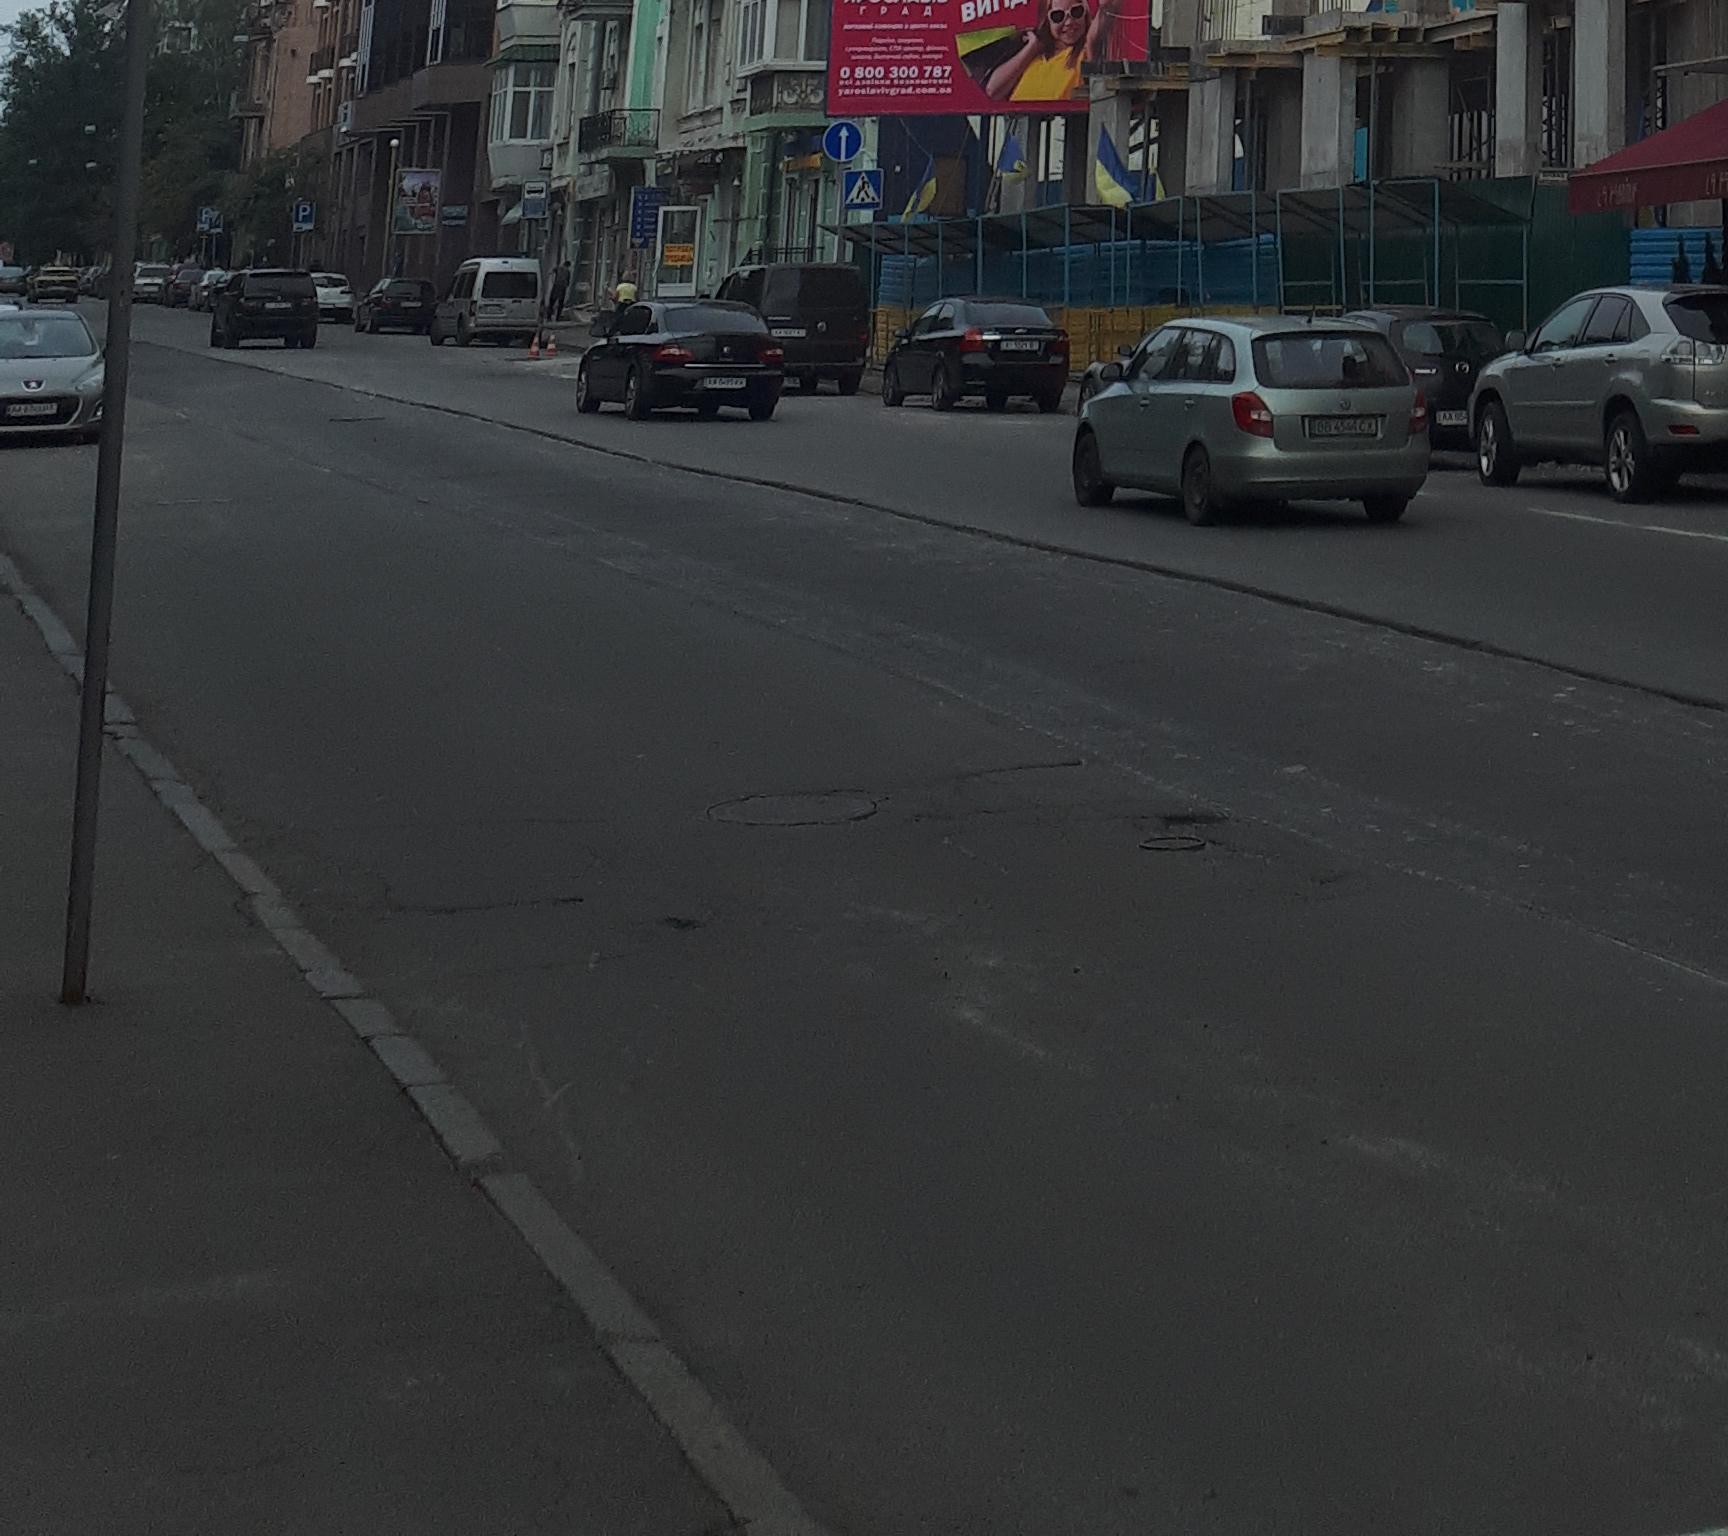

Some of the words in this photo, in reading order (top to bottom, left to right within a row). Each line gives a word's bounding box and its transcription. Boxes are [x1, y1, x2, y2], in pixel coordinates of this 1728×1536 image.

[840, 66, 850, 79] 0
[855, 66, 885, 79] 800
[889, 66, 918, 79] 300
[923, 66, 952, 79] 787
[299, 205, 311, 222] P
